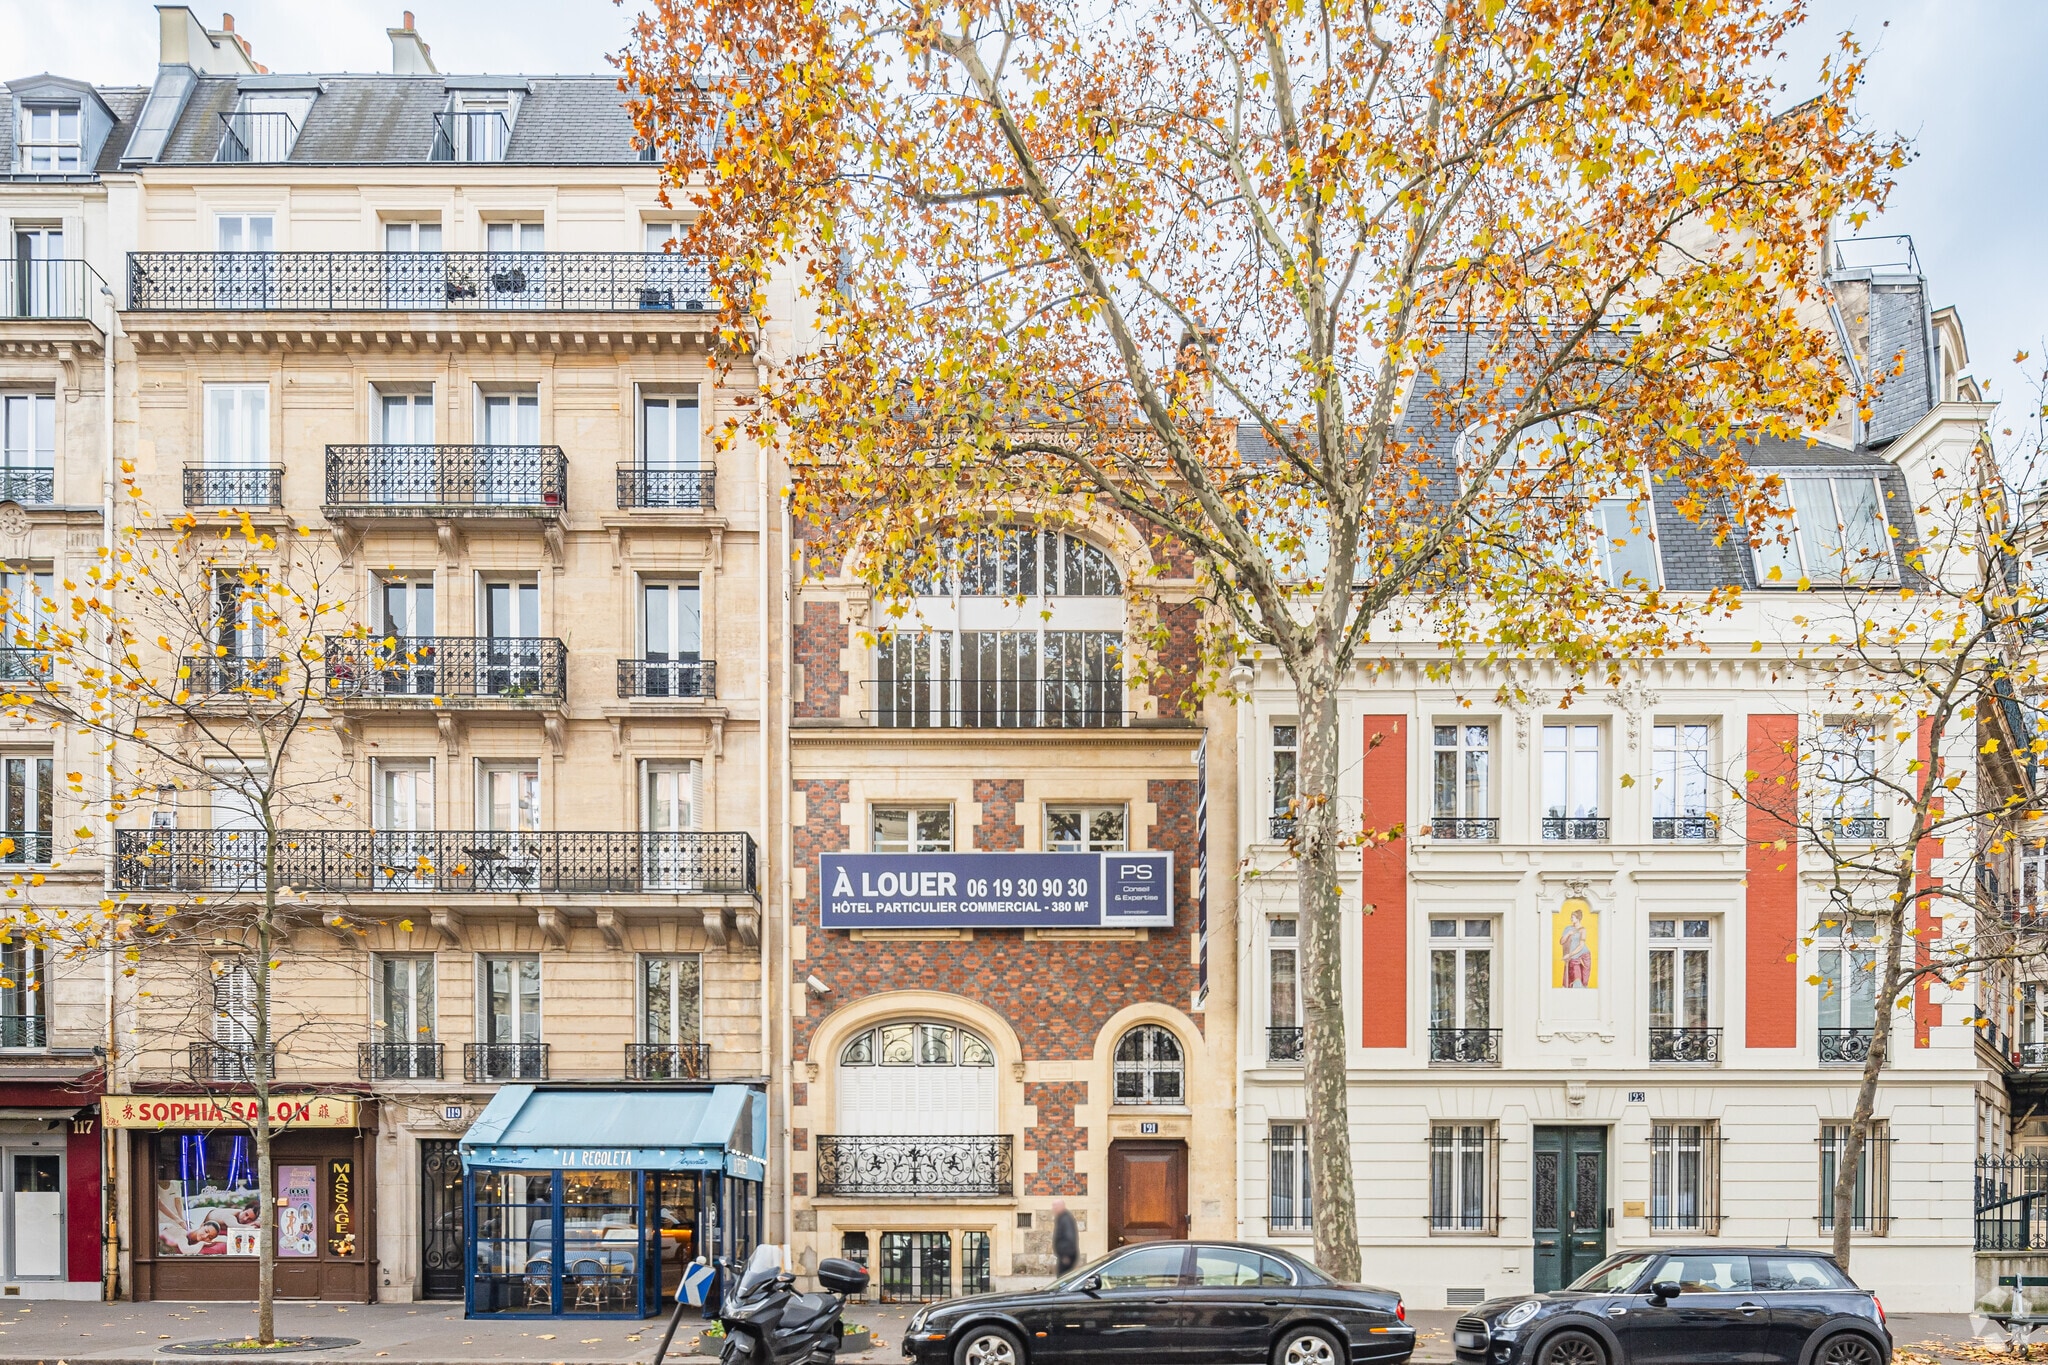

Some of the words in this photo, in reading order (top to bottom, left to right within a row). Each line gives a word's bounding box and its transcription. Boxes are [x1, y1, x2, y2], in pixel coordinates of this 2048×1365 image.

[1120, 864, 1153, 880] PS
[832, 866, 855, 897] À
[862, 872, 957, 897] LOUER
[966, 878, 988, 898] 06
[993, 878, 1013, 898] 19
[1017, 878, 1038, 898] 30
[1042, 878, 1063, 898] 90
[1067, 878, 1088, 898] 30
[1122, 894, 1159, 902] Expertise
[832, 901, 873, 914] HÔTEL
[876, 902, 957, 914] PARTICULIER
[960, 902, 1041, 913] COMMERCIAL
[1051, 901, 1072, 912] 380
[1074, 901, 1089, 912] M²
[1629, 1092, 1645, 1102] 123
[139, 1103, 224, 1121] SOPHIA
[447, 1107, 461, 1118] 119
[73, 1120, 94, 1134] 117
[1143, 1123, 1156, 1133] 121
[562, 1151, 575, 1166] LA
[333, 1163, 351, 1234] MASSAGE
